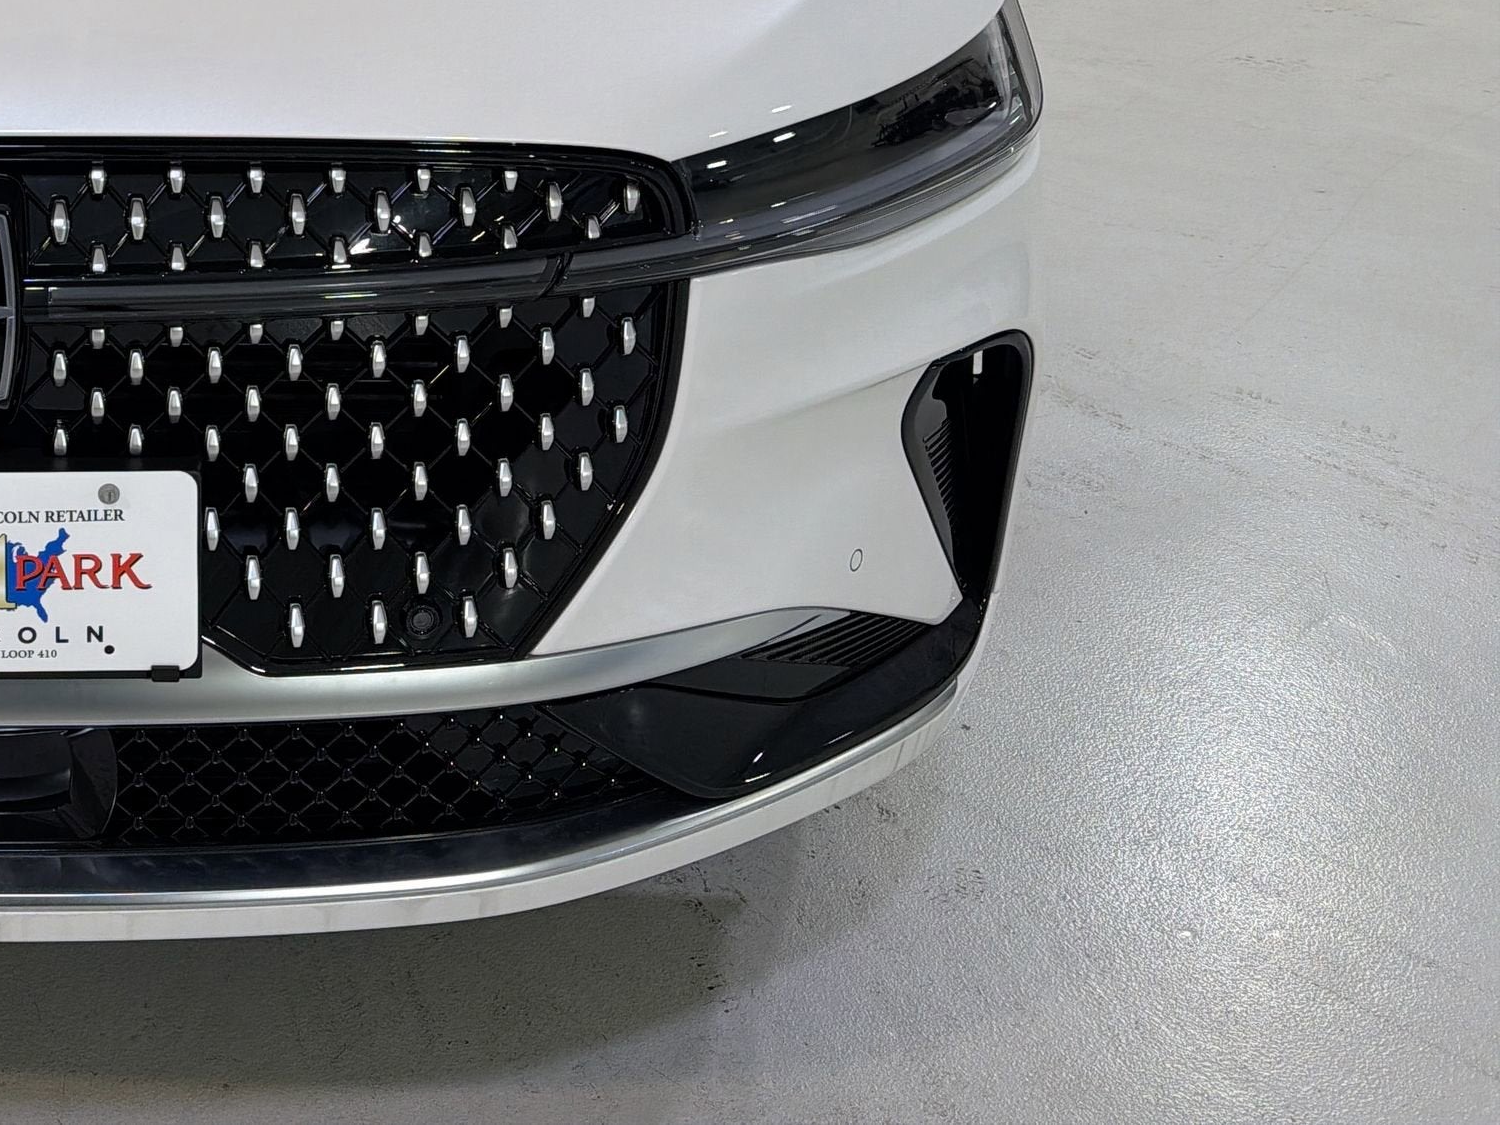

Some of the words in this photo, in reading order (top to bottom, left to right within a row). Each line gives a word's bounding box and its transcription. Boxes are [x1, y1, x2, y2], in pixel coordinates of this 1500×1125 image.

[44, 509, 125, 523] RETAILER
[15, 552, 152, 592] PARK
[1, 649, 36, 660] LOOP
[38, 649, 58, 660] 410
